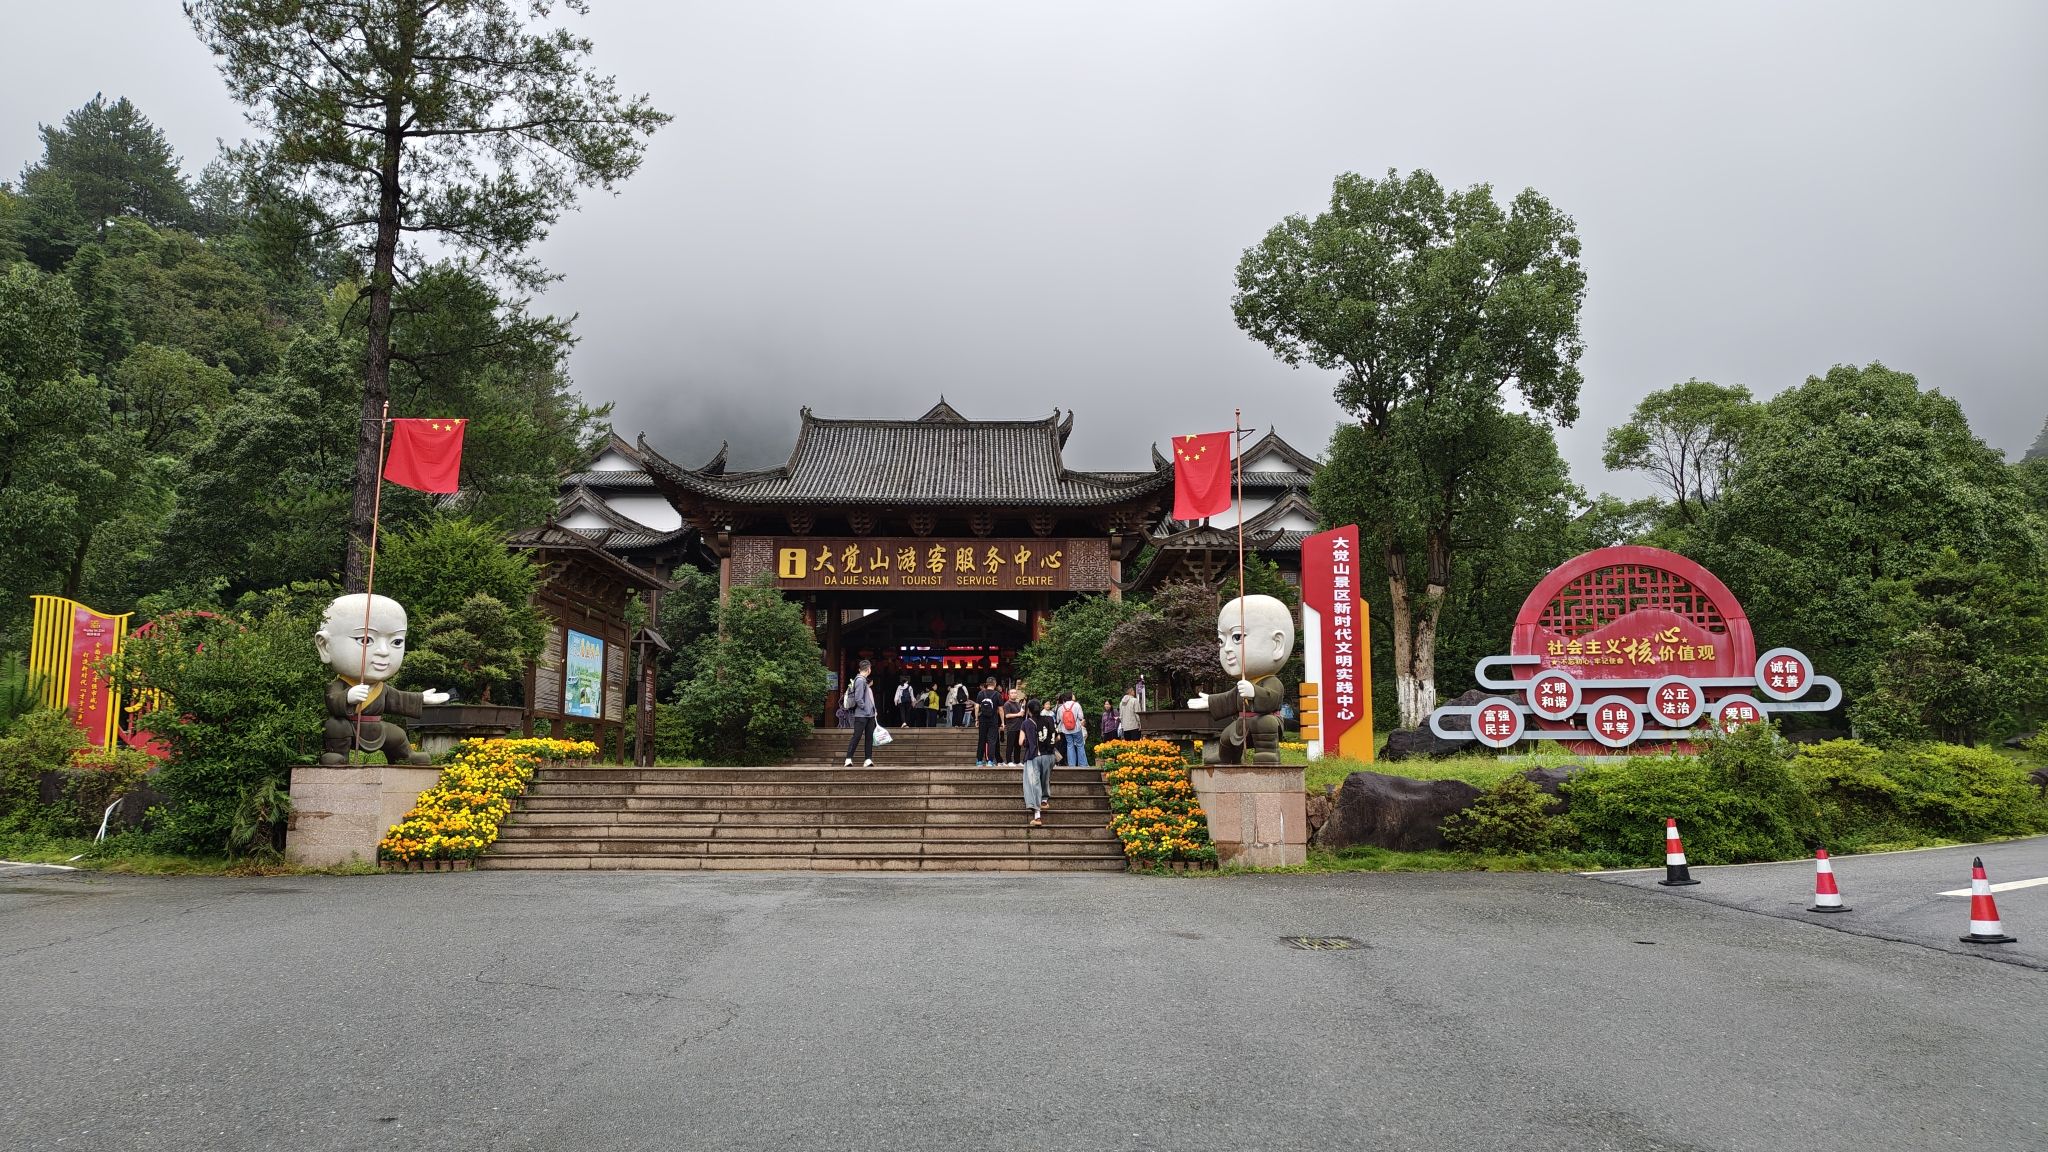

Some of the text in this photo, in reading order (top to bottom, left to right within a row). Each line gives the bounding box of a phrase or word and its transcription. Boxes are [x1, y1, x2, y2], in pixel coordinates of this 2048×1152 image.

[813, 543, 1063, 575] 大觉山游客服务中心
[824, 575, 1054, 586] DA JUE SHAN TOURIST SERVICE CENTRE
[1332, 536, 1355, 720] 大觉山景区新时代文明实践中心
[1770, 661, 1798, 674] 诚信
[1771, 675, 1799, 688] 友善
[1541, 682, 1567, 694] 文明
[1661, 688, 1690, 700] 公正
[1541, 696, 1568, 708] 和谐
[1662, 702, 1690, 714] 法治
[1484, 709, 1510, 722] 富强
[1602, 708, 1628, 720] 自由
[1725, 707, 1753, 719] 爱国
[1485, 723, 1511, 735] 民主
[1602, 722, 1629, 734] 平等
